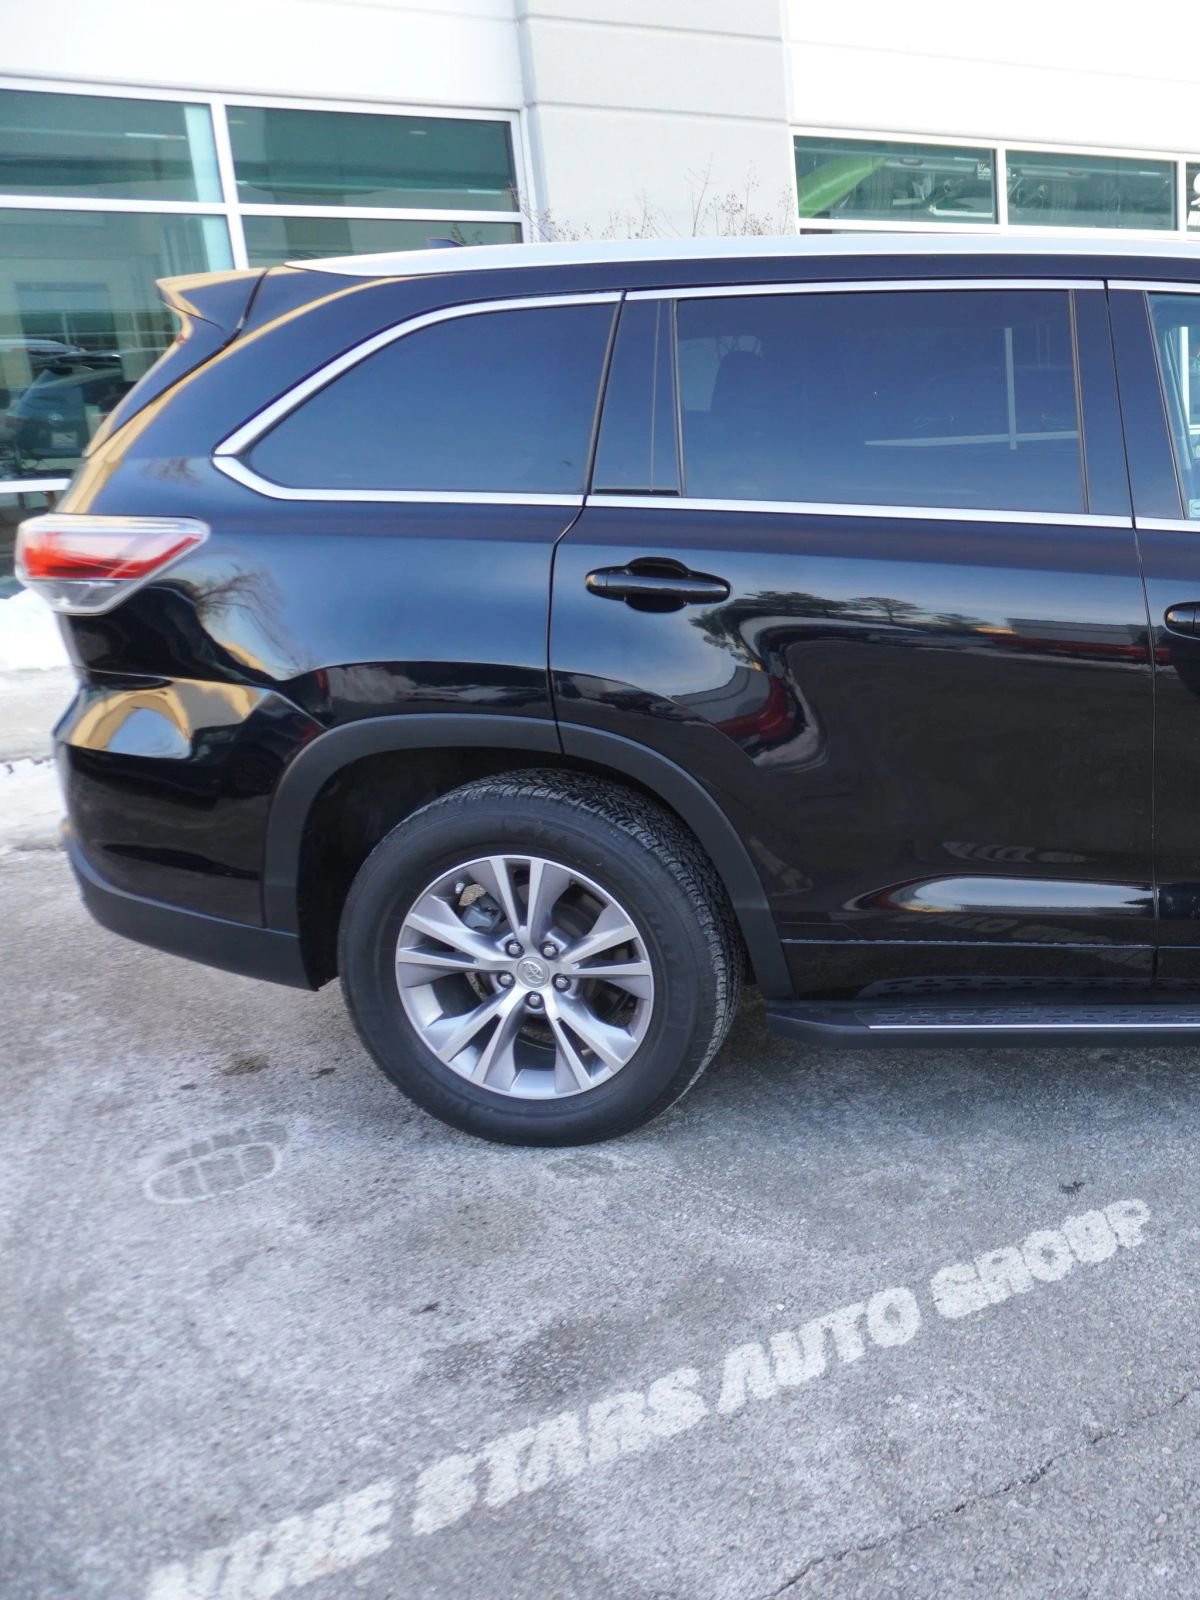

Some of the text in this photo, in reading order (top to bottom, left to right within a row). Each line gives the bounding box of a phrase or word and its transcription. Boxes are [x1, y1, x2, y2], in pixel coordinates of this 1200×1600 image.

[410, 1366, 709, 1536] STARS
[718, 1286, 921, 1414] AUTO
[930, 1199, 1151, 1319] GROUP
